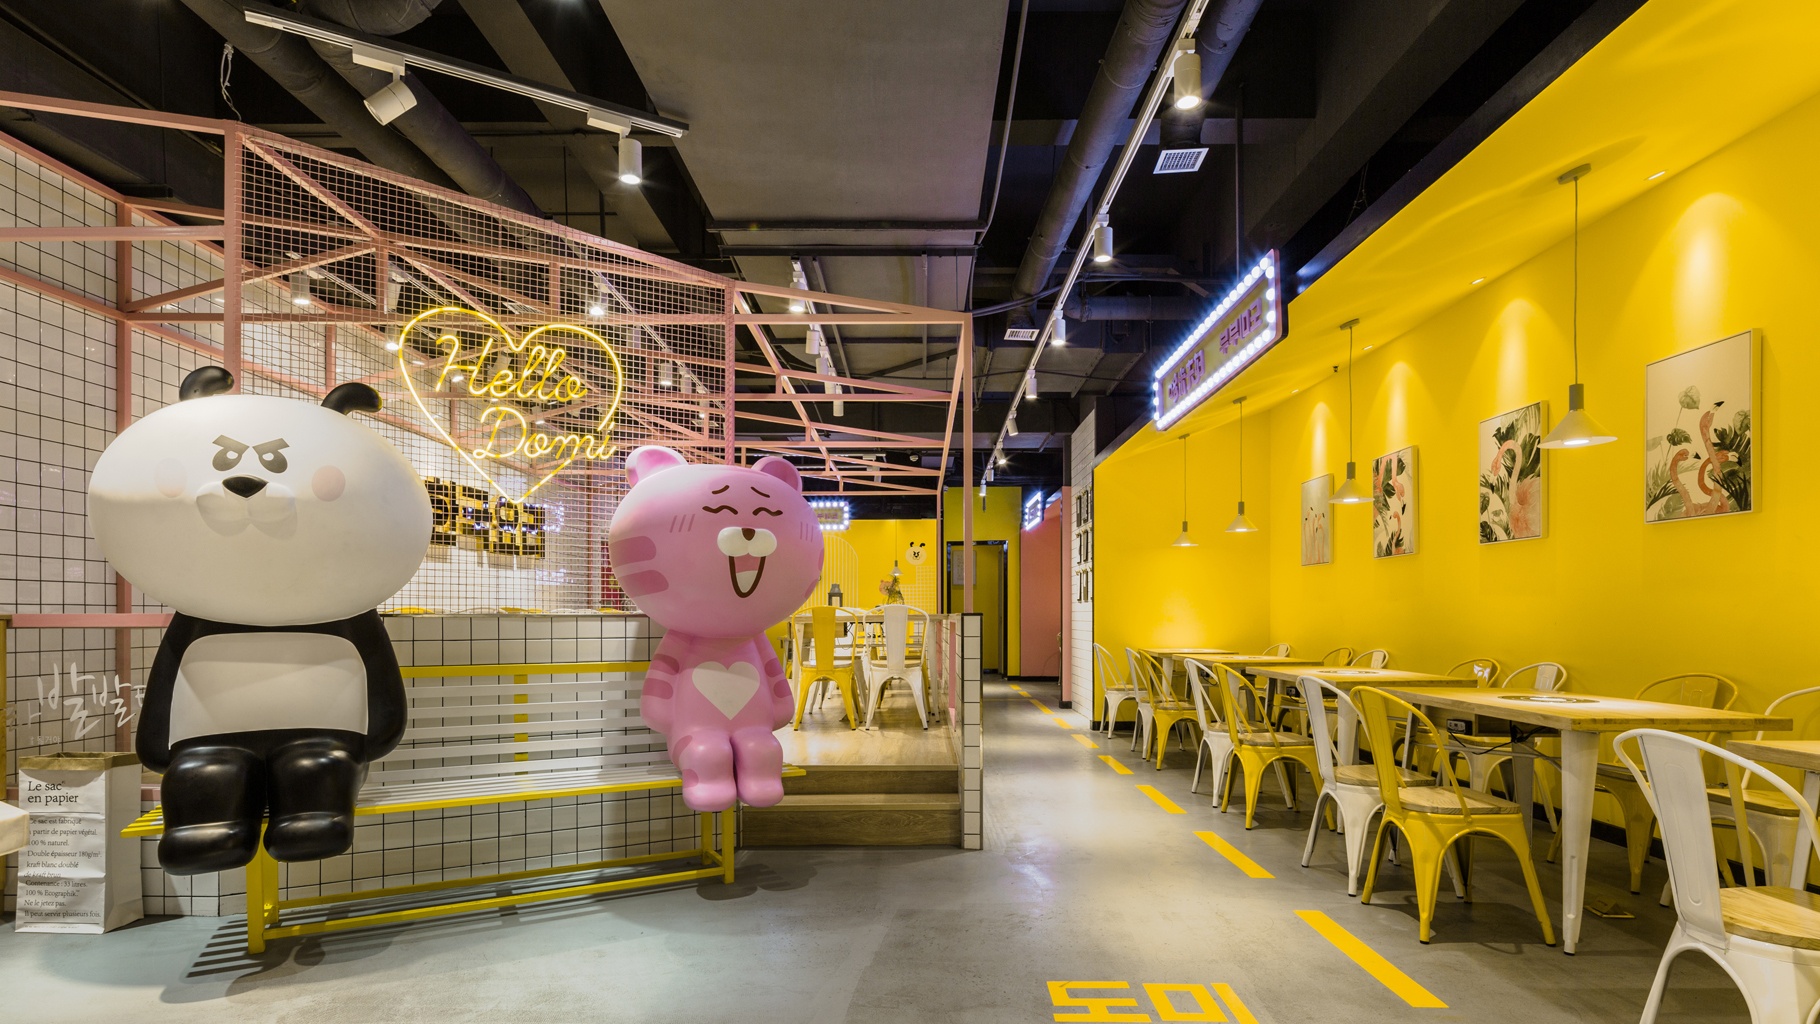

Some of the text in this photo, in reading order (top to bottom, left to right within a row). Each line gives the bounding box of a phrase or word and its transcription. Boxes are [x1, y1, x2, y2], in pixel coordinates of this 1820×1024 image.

[436, 334, 588, 401] Hello
[472, 406, 617, 459] Domi
[28, 781, 42, 791] Le
[27, 792, 79, 806] en papier
[32, 828, 50, 837] partir
[59, 829, 77, 837] papier
[78, 828, 98, 838] végétal.
[29, 839, 69, 847] 00 % naturel.
[27, 850, 50, 858] Double
[51, 850, 78, 859] épaisseur
[58, 861, 79, 869] doublé
[1046, 981, 1260, 1024] 도미
